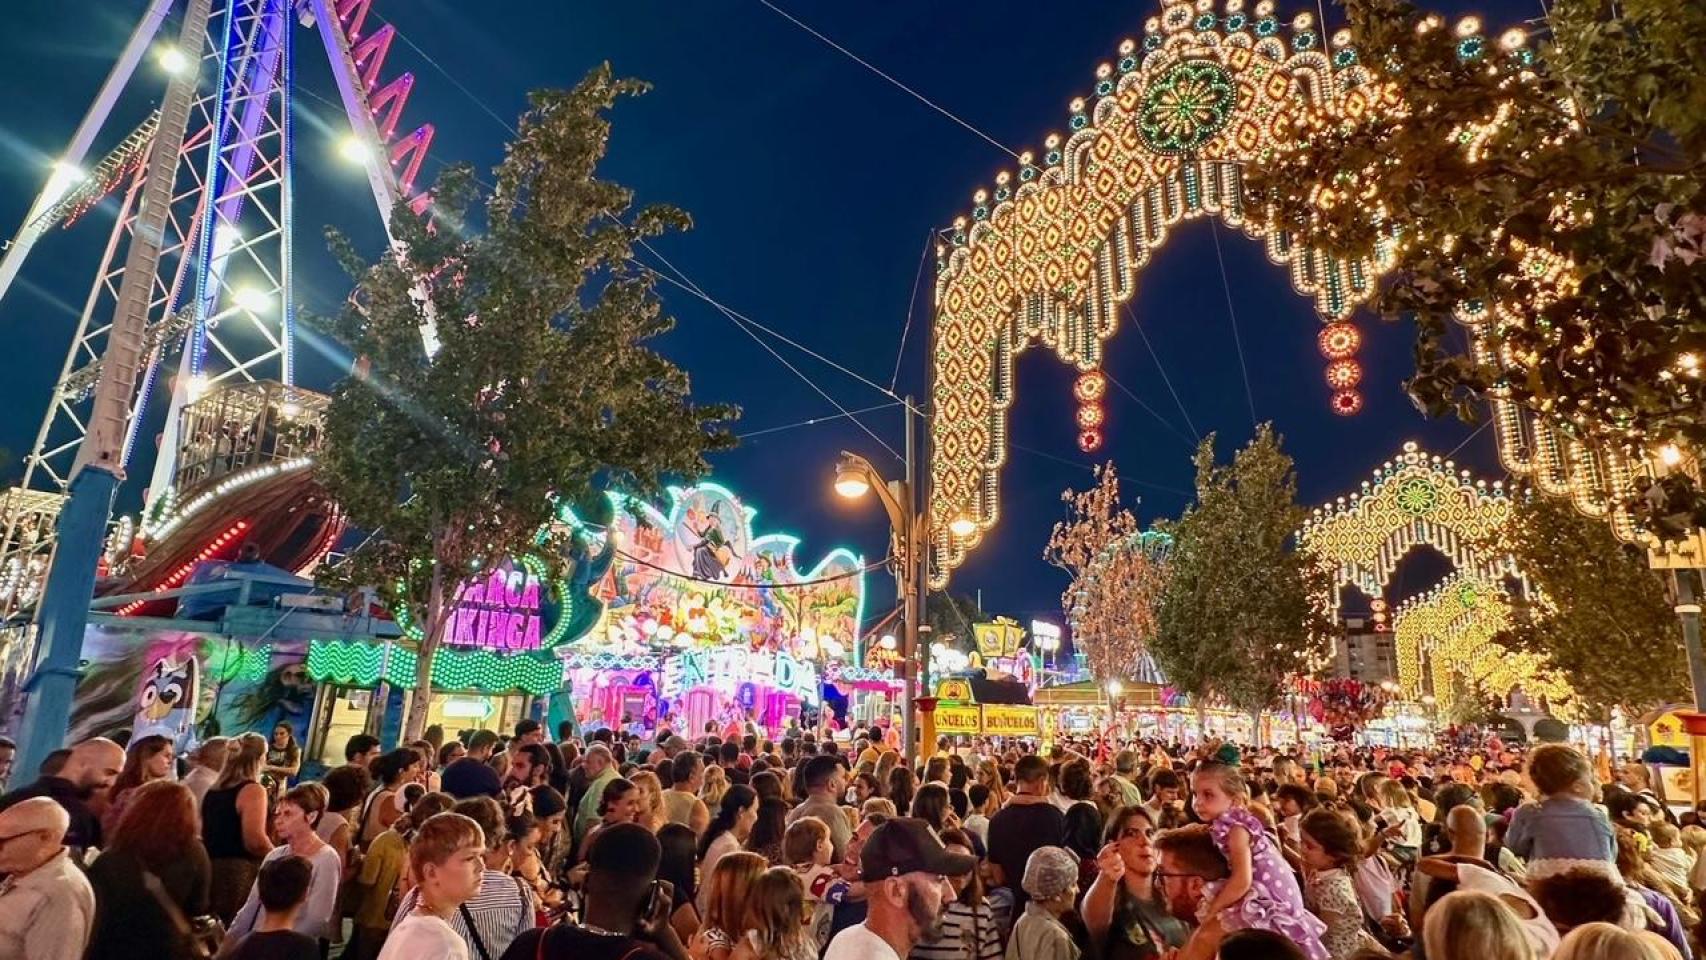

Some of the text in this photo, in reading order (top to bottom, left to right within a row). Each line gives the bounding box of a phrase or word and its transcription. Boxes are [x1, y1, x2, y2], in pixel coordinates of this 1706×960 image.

[453, 568, 540, 609] ARCA
[442, 608, 541, 649] IKINGA
[663, 646, 820, 706] ENTRADA
[935, 711, 978, 727] UÑUELOS
[987, 713, 1035, 729] BUÑUELOS
